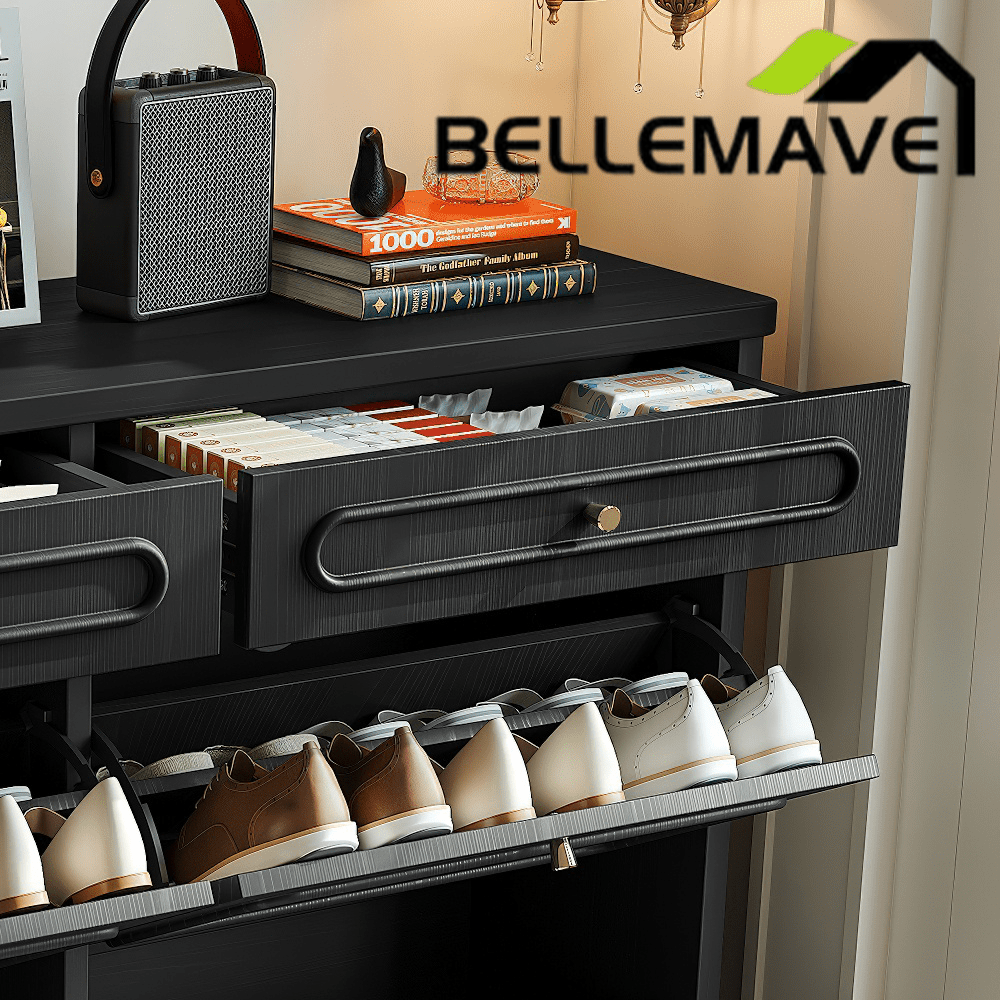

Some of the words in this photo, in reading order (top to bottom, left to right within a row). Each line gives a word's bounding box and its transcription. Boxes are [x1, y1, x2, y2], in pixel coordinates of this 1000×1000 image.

[369, 228, 435, 253] 1000
[420, 263, 438, 274] The
[439, 258, 482, 272] Godfather
[483, 254, 512, 266] Family
[512, 251, 539, 263] Album
